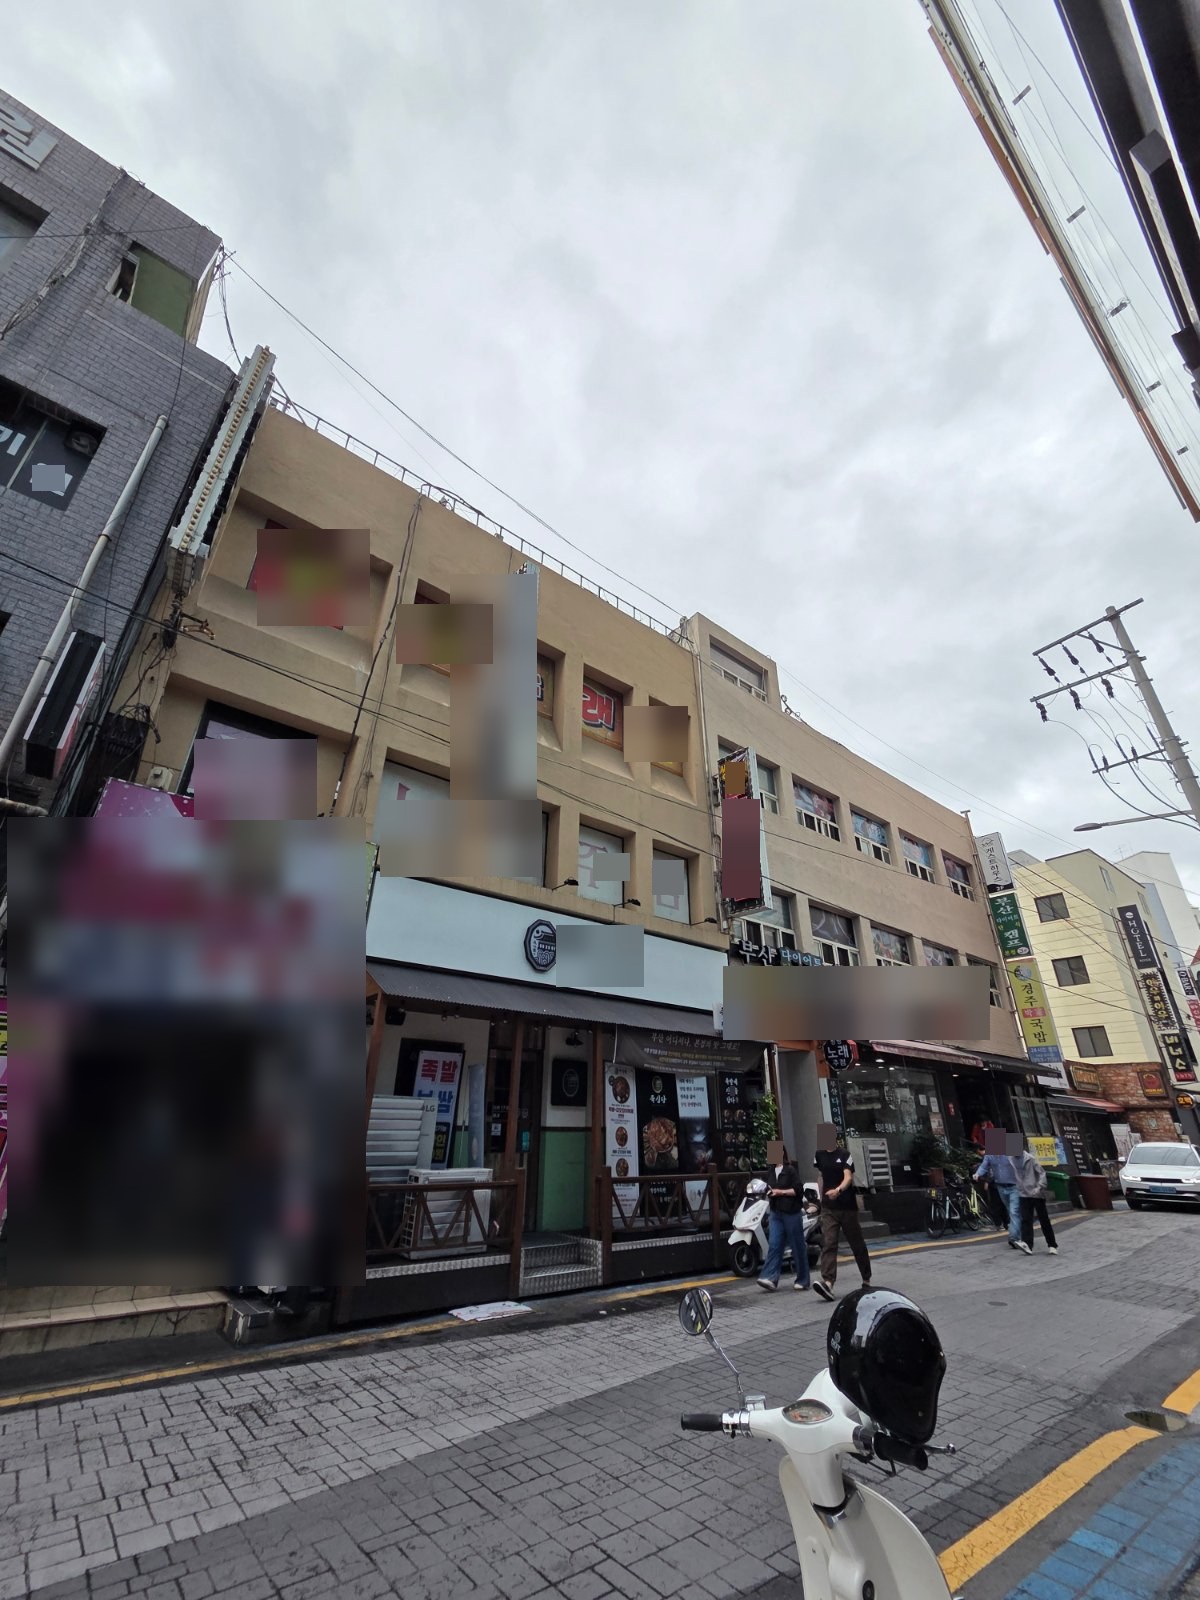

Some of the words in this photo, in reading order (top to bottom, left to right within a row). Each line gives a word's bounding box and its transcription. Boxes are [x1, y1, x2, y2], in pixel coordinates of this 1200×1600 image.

[986, 847, 1002, 882] 게스트하우스
[995, 897, 1014, 915] 부산
[1003, 929, 1024, 948] 캠프
[1128, 920, 1147, 957] HOTEL
[739, 940, 777, 966] 부산
[781, 949, 821, 966] 다이어트
[1022, 983, 1038, 1007] 경주
[1030, 1019, 1048, 1043] 국밥
[827, 1044, 849, 1058] 노래
[420, 1059, 458, 1083] 족발
